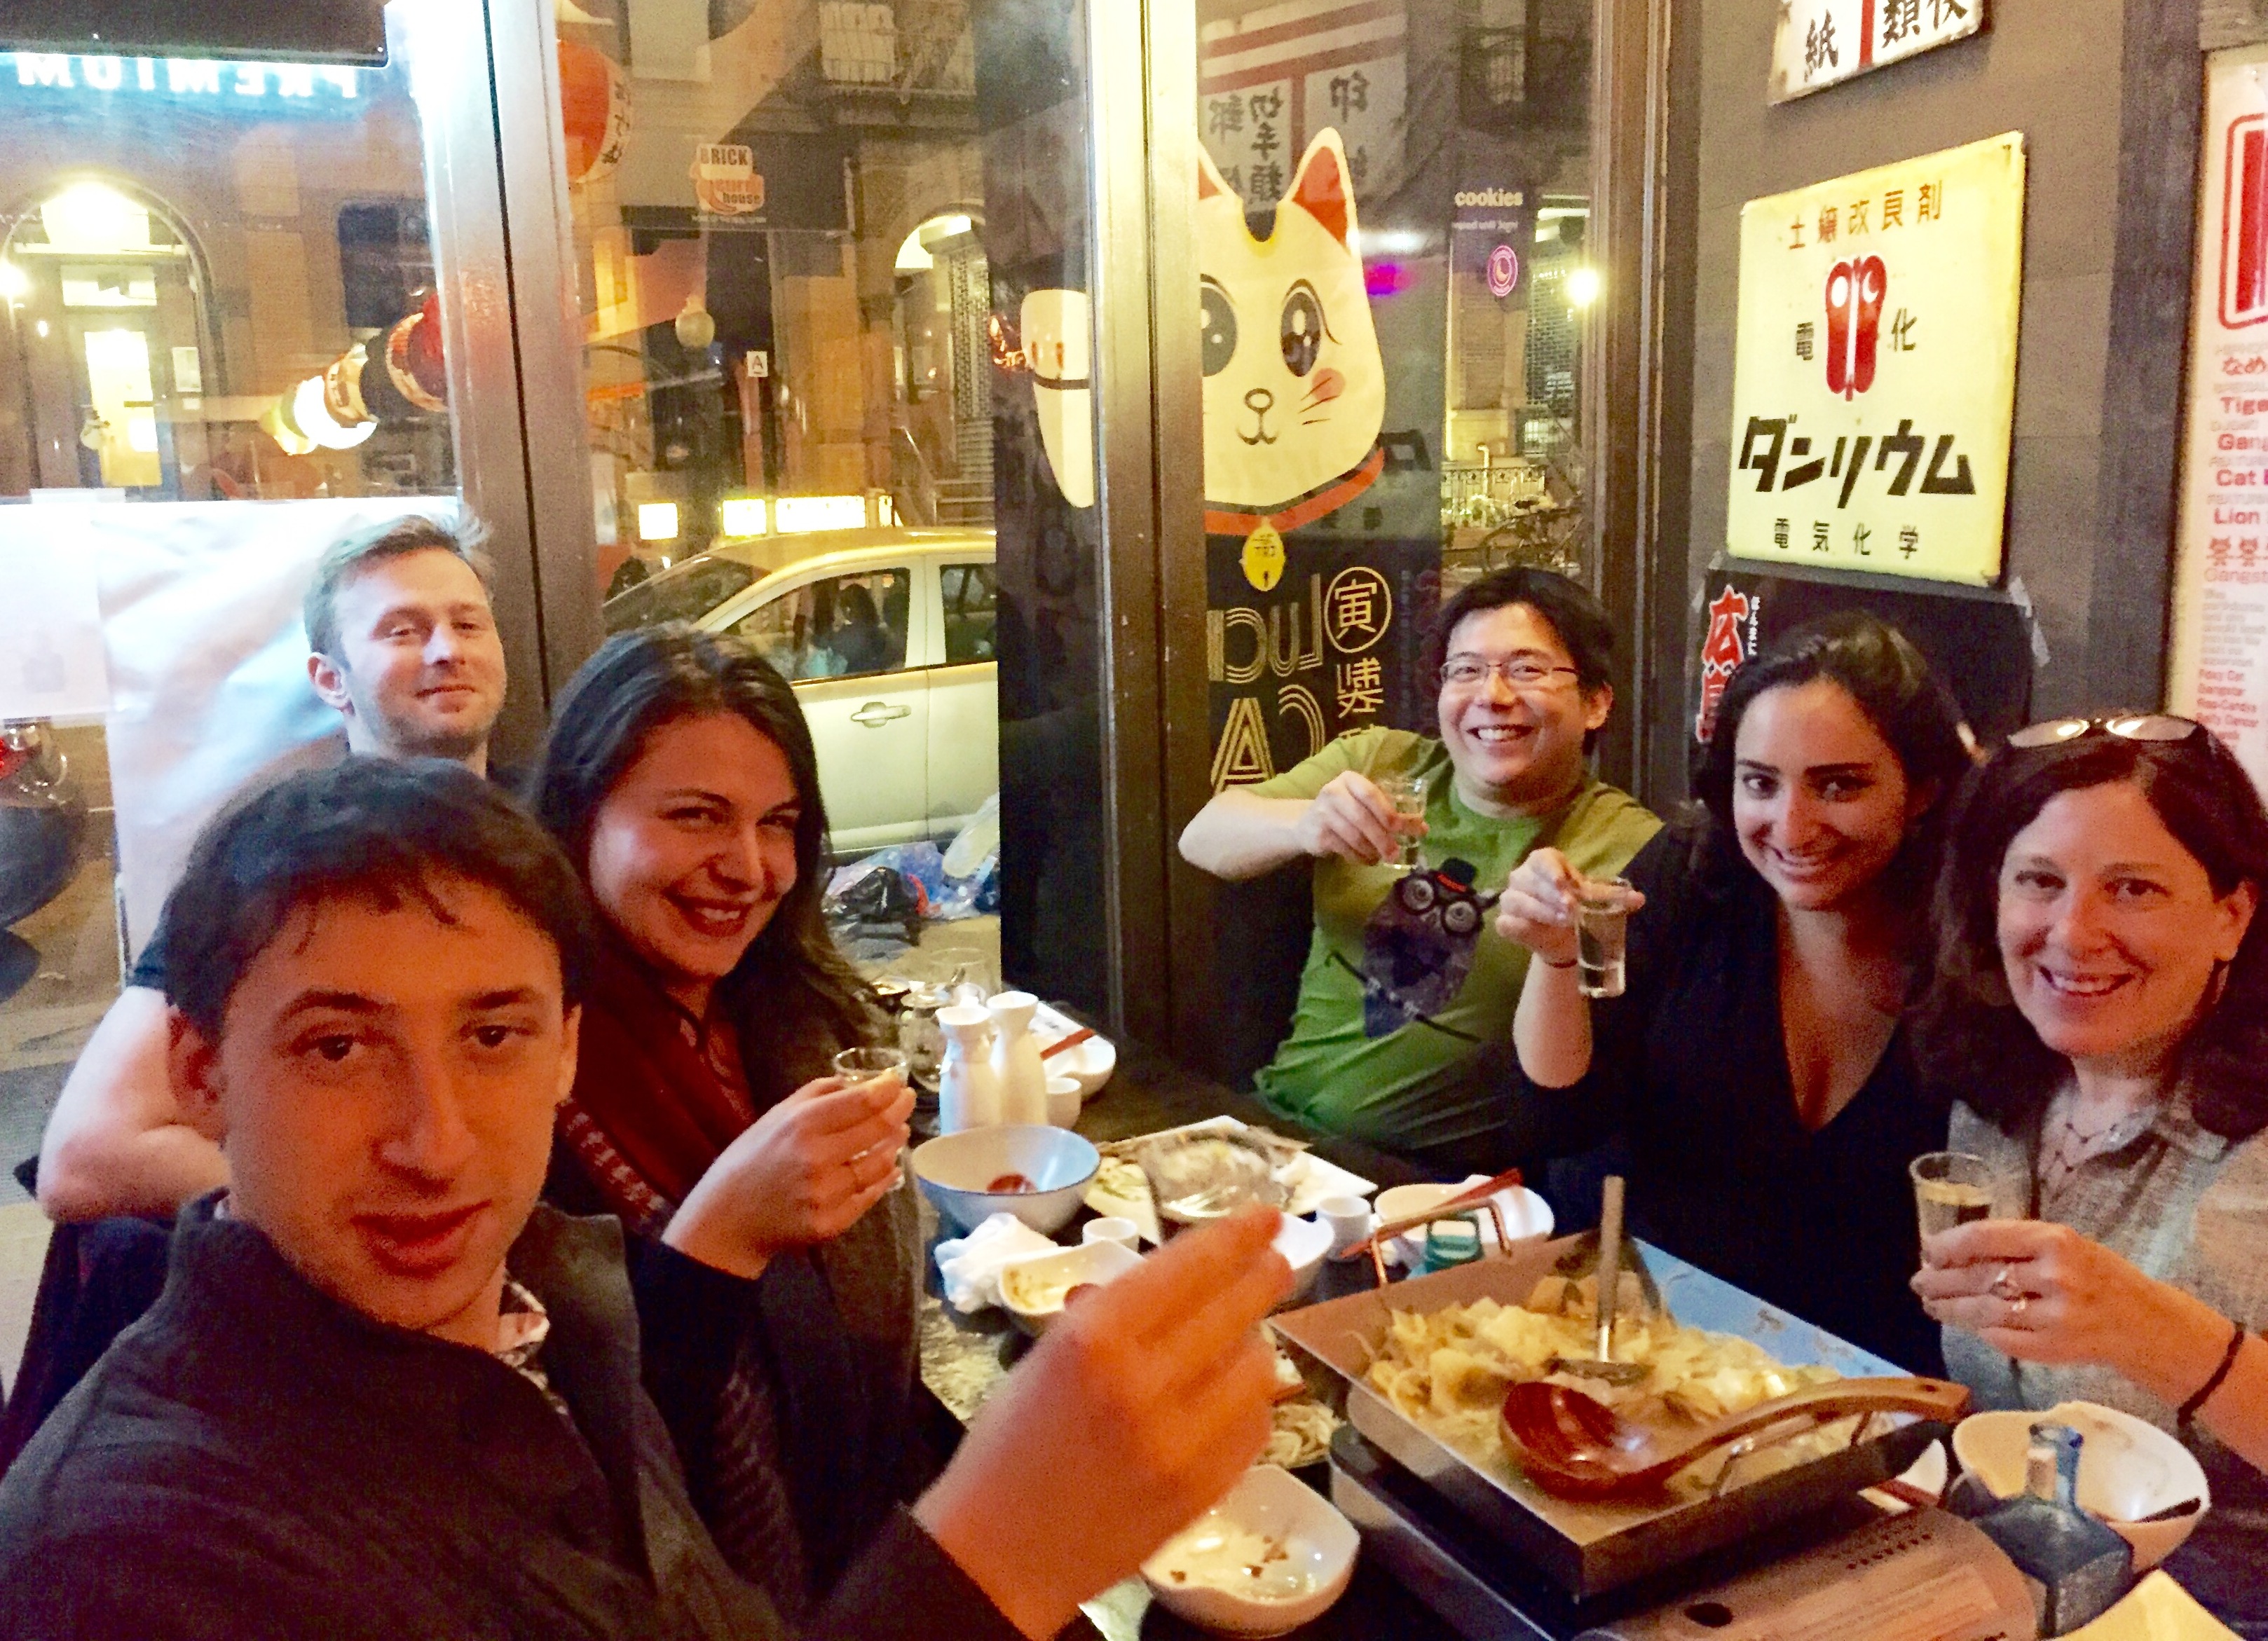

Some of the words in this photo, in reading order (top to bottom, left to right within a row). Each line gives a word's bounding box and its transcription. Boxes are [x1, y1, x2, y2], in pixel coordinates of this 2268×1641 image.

[1803, 8, 1839, 83] 紙
[700, 147, 749, 165] BRICK
[722, 192, 761, 205] house
[1454, 187, 1523, 207] cookies
[1891, 308, 1918, 352] 化
[751, 355, 764, 370] A
[1738, 413, 1976, 509] ダンリウム
[2215, 468, 2256, 486] Cat
[2214, 506, 2260, 525] Lion
[1774, 517, 1919, 559] 電気化学
